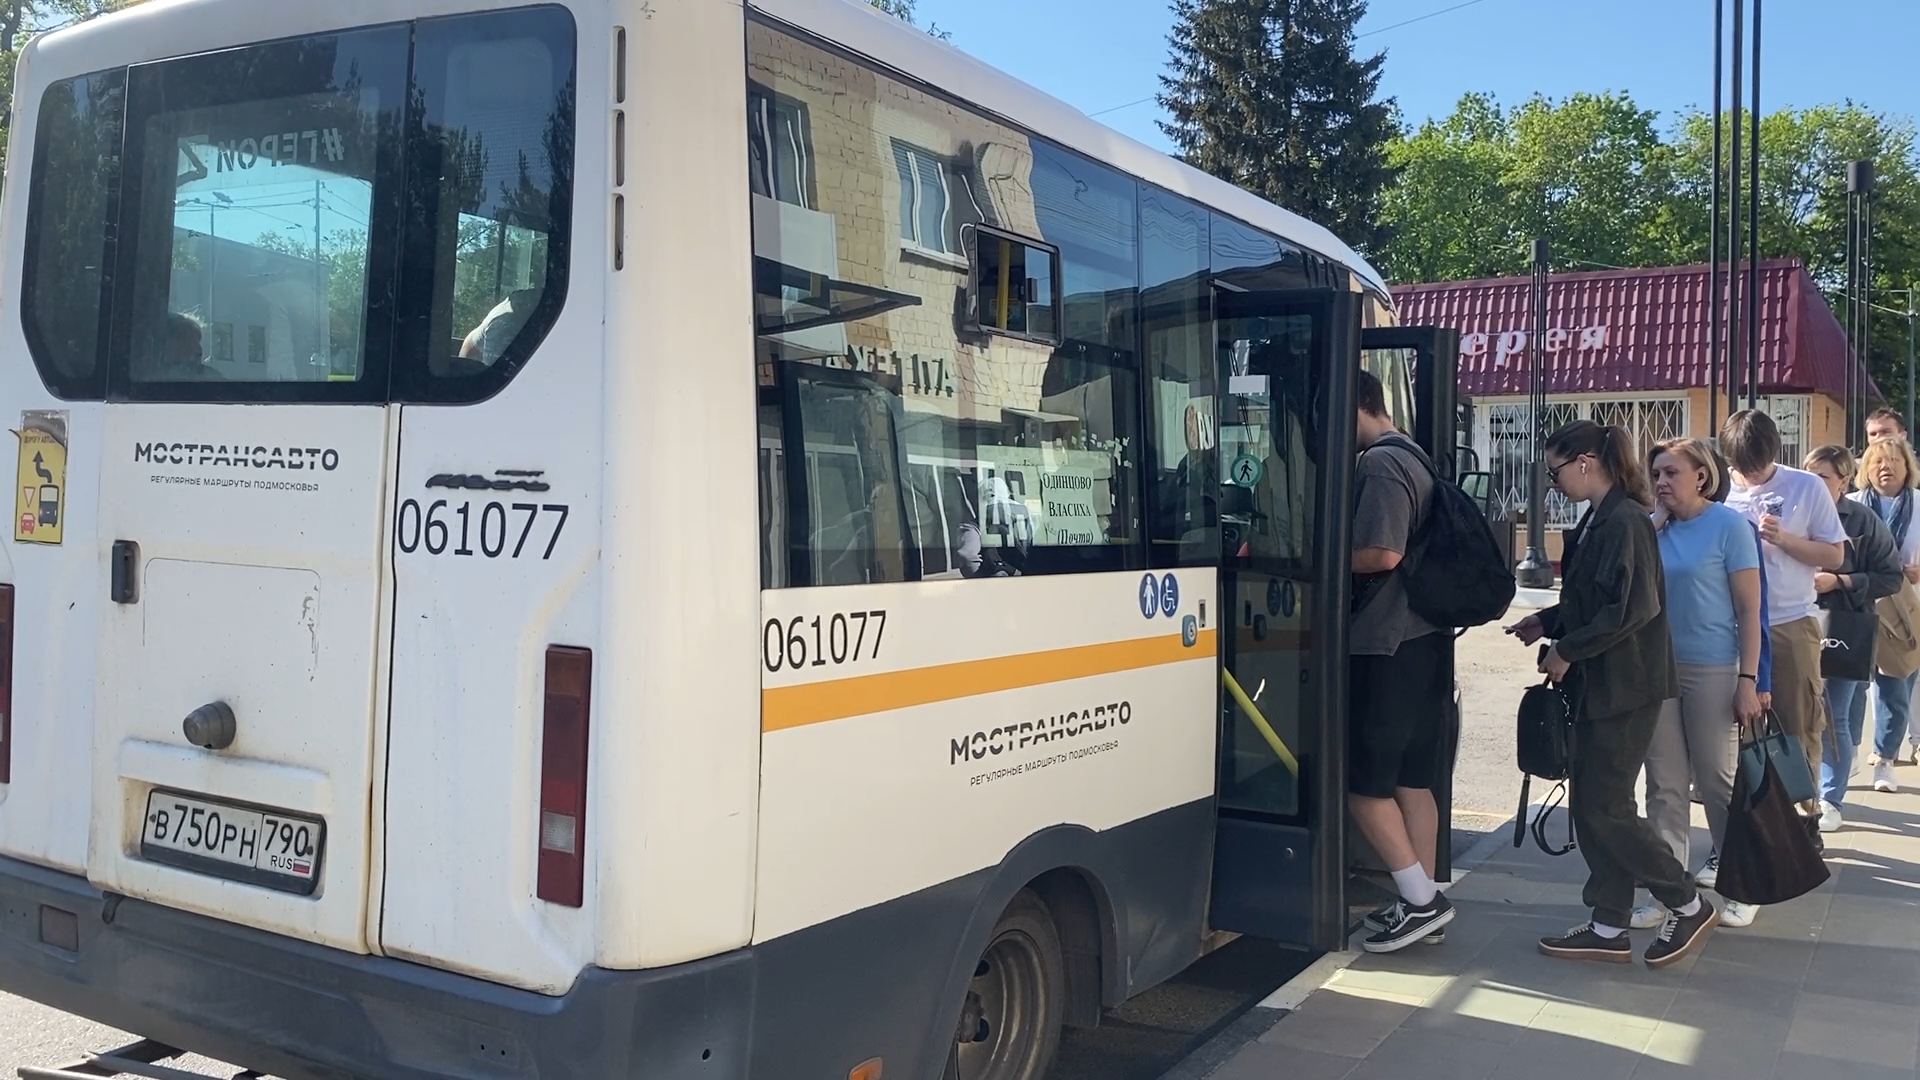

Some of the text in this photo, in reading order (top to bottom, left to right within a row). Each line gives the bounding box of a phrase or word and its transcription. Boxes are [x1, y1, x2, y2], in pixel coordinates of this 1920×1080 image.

[134, 442, 339, 471] МОСТРАНСАВТО
[150, 475, 319, 492] РЕГУЛЯРНЫЕ МАРШРУТЫ ПОДМОСКОВЬЯ
[1042, 473, 1092, 490] ОДИНЦОВО
[398, 498, 569, 560] 061077
[1057, 529, 1094, 545] (Почта)
[763, 610, 886, 672] 061077
[950, 701, 1131, 765] МОСТРАНСАВТО
[970, 740, 1119, 786] РЕГУЛЯРНЫЕ МАРШРУТЫ ПОДМОСКОВЬЯ
[154, 804, 309, 860] В750РН 790
[270, 855, 293, 870] RUS
